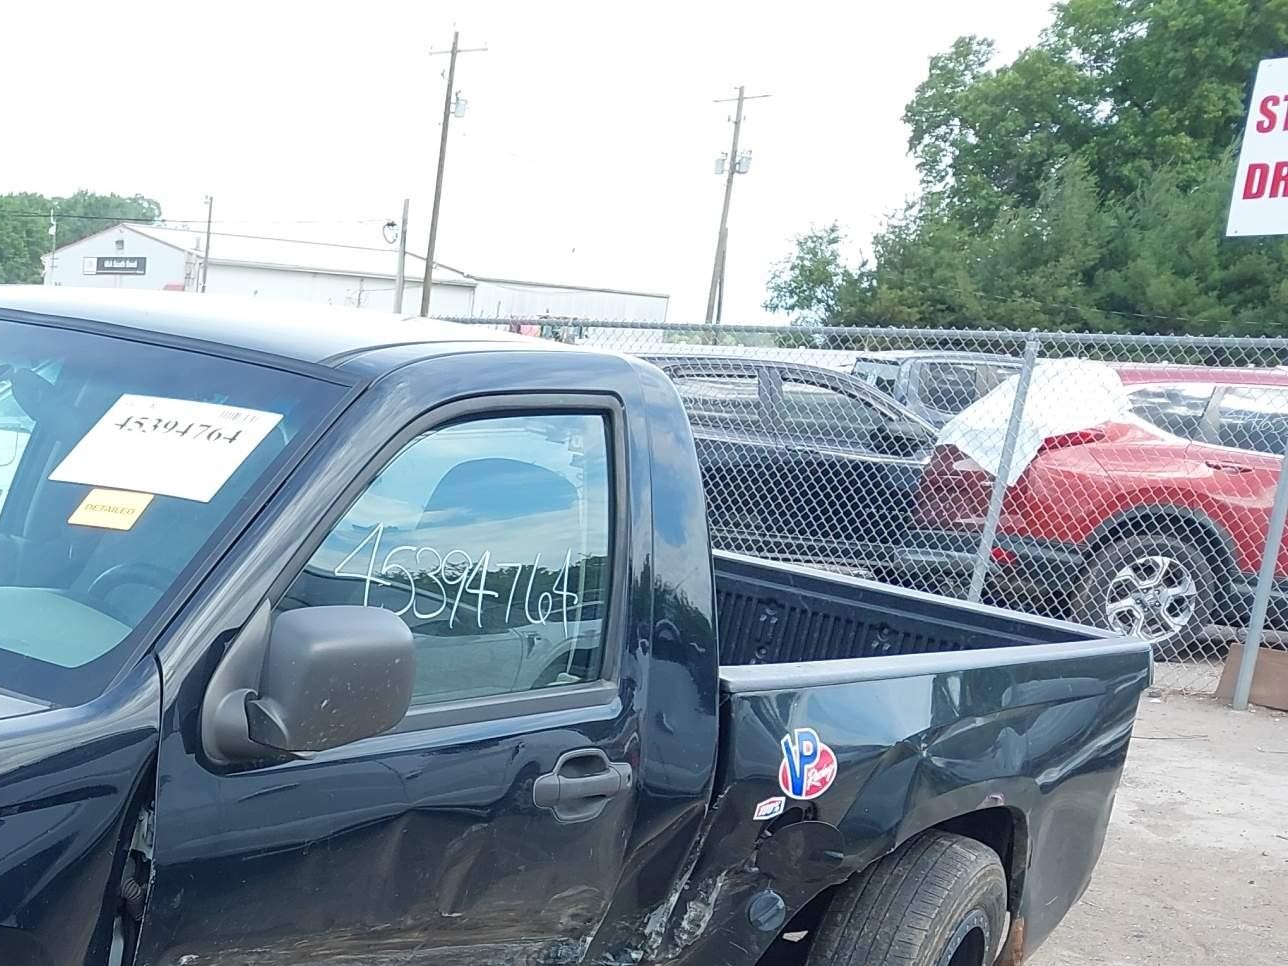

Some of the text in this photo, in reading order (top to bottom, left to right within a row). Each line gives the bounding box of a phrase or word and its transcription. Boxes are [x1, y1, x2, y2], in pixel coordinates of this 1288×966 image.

[1256, 95, 1288, 133] S
[114, 415, 243, 444] 45394764
[84, 503, 136, 515] DETAILED
[334, 521, 579, 641] 45394764
[781, 728, 820, 798] VP
